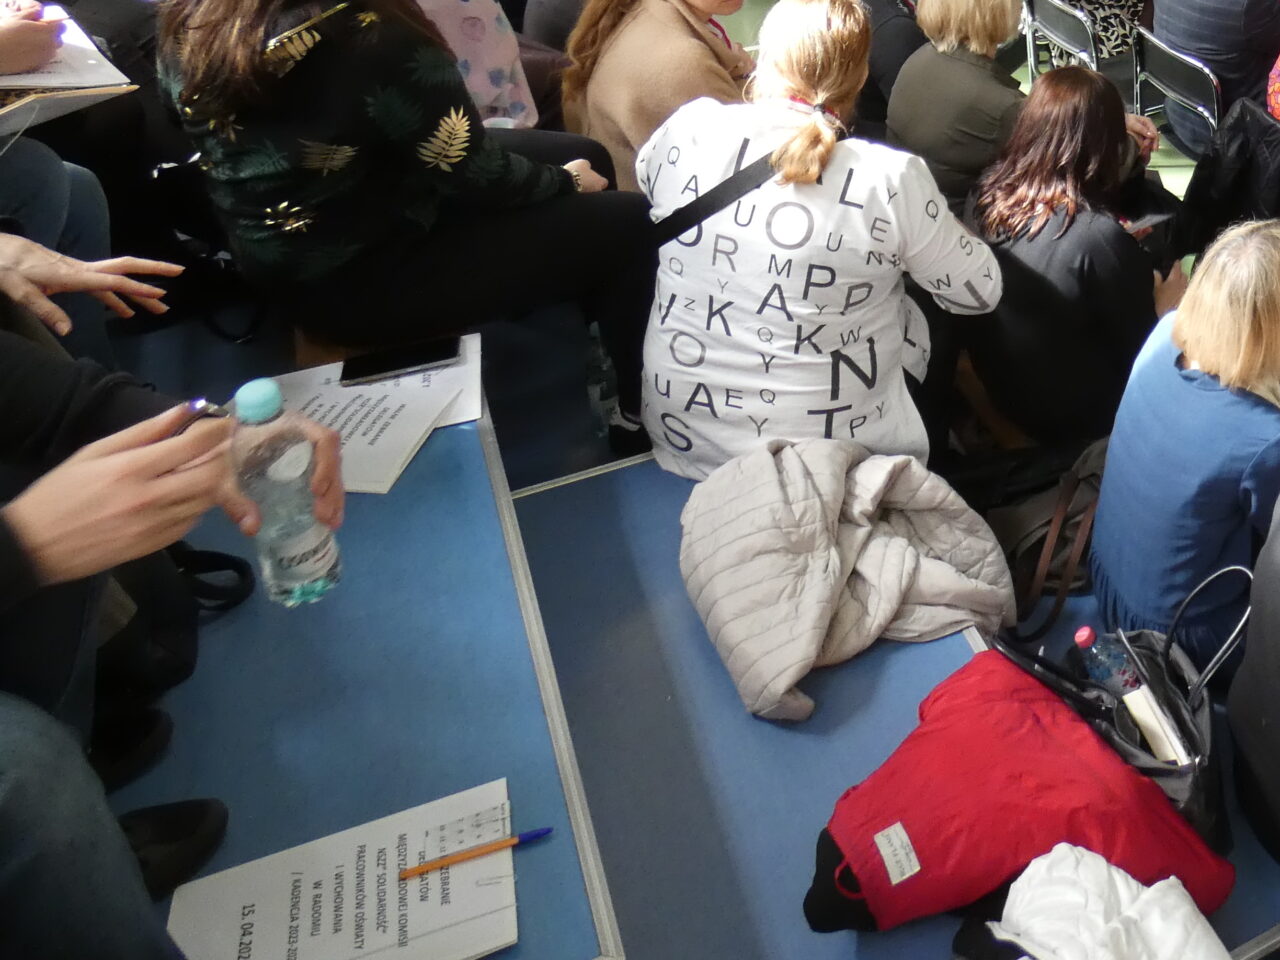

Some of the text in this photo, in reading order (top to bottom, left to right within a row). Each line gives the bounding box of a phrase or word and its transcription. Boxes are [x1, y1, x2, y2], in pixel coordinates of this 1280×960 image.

[667, 146, 681, 167] Q
[681, 174, 699, 199] A
[839, 168, 864, 210] L
[734, 200, 756, 227] U
[765, 201, 814, 251] O
[925, 200, 939, 223] Q
[826, 232, 843, 252] U
[870, 217, 892, 243] E
[712, 233, 739, 273] R
[768, 253, 793, 279] M
[802, 263, 837, 301] P
[840, 282, 874, 316] P
[706, 294, 735, 337] K
[756, 283, 794, 322] A
[669, 331, 706, 368] O
[757, 326, 773, 344] Q
[794, 324, 827, 355] K
[840, 326, 862, 346] W
[758, 352, 776, 374] Y
[830, 336, 878, 402] N
[684, 382, 720, 419] A
[725, 388, 743, 409] E
[760, 389, 776, 406] Q
[661, 412, 693, 452] S
[748, 415, 769, 437] Y
[807, 404, 852, 439] T
[850, 415, 867, 438] P
[355, 845, 367, 910] PRACOWNIKÓW
[418, 850, 431, 903] DELGATÓW
[289, 878, 302, 923] KADENCJA
[310, 893, 323, 937] RADOMIU
[332, 871, 345, 935] WYCHOWANIA
